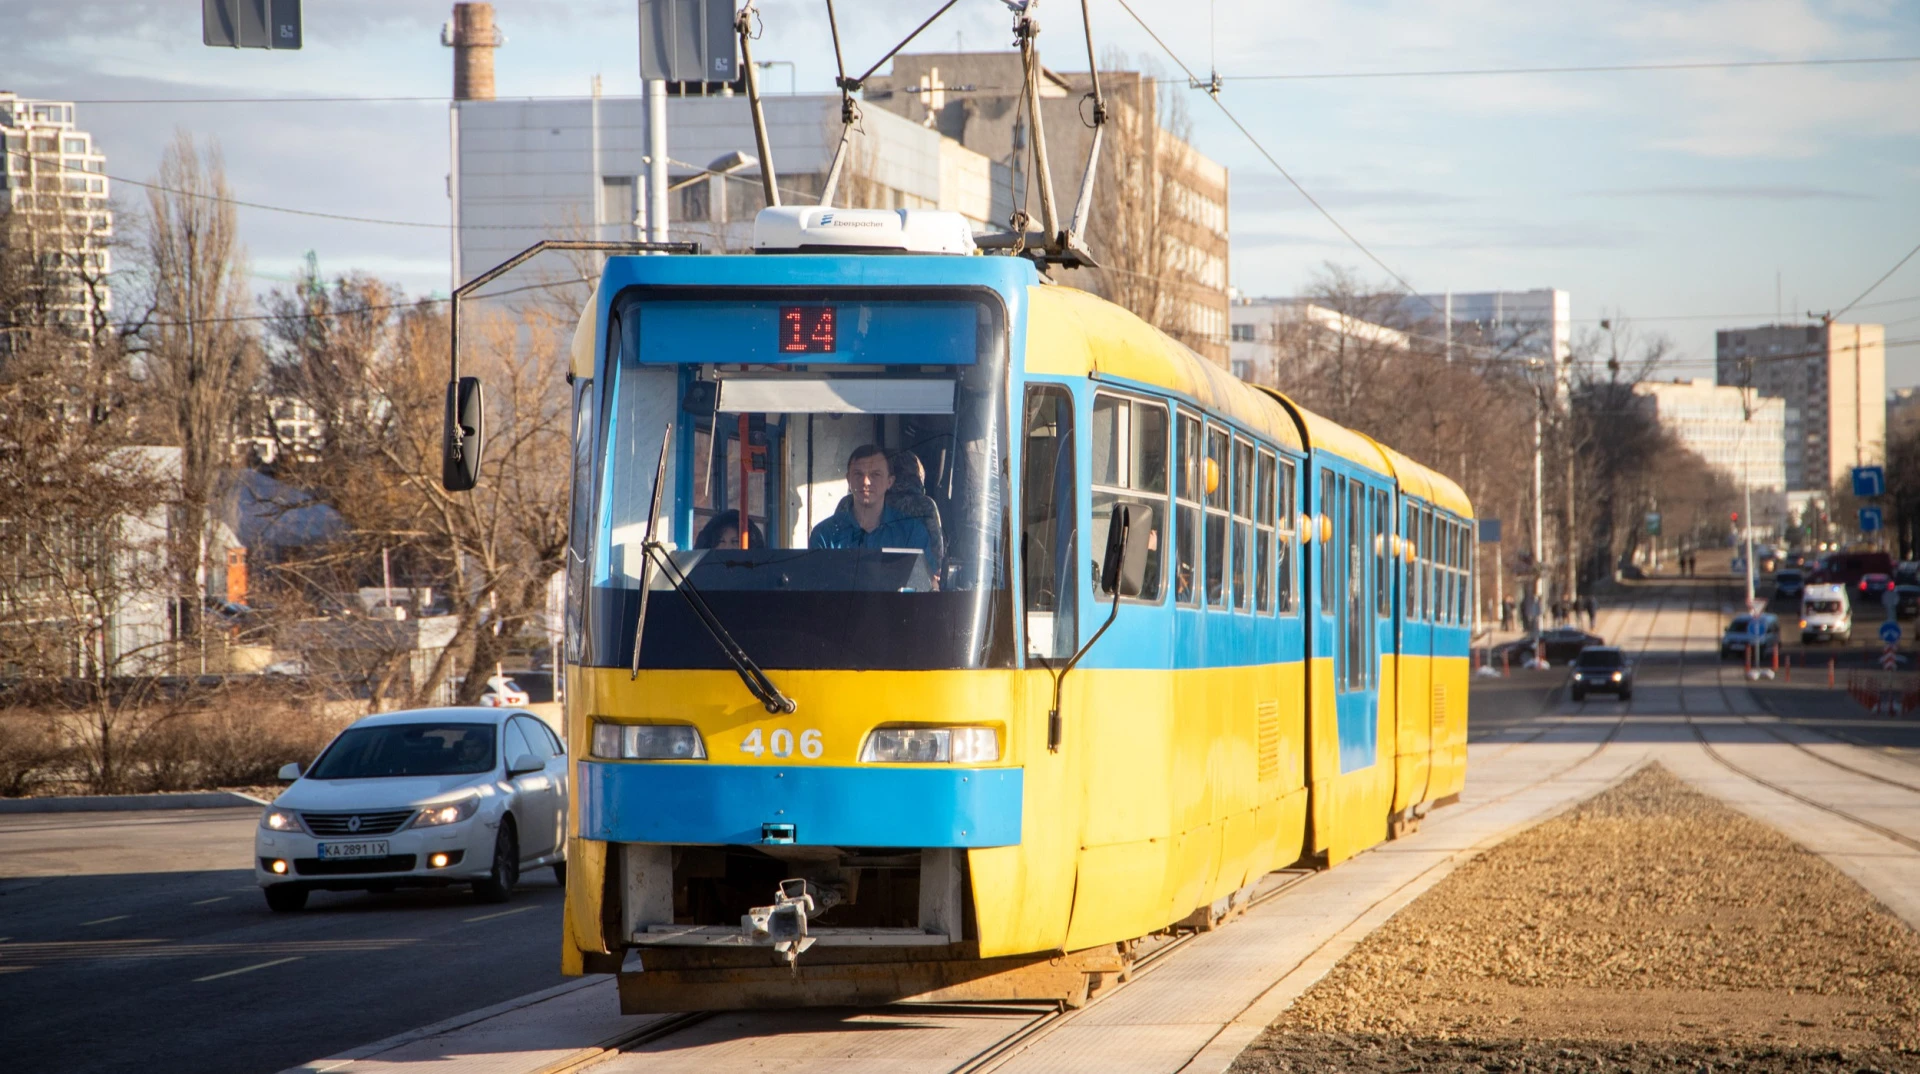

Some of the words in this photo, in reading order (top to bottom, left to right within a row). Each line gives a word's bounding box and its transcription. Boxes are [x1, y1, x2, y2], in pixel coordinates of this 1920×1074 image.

[786, 308, 833, 350] 14
[740, 727, 823, 758] 406
[325, 845, 341, 856] KA
[343, 844, 367, 856] 2891
